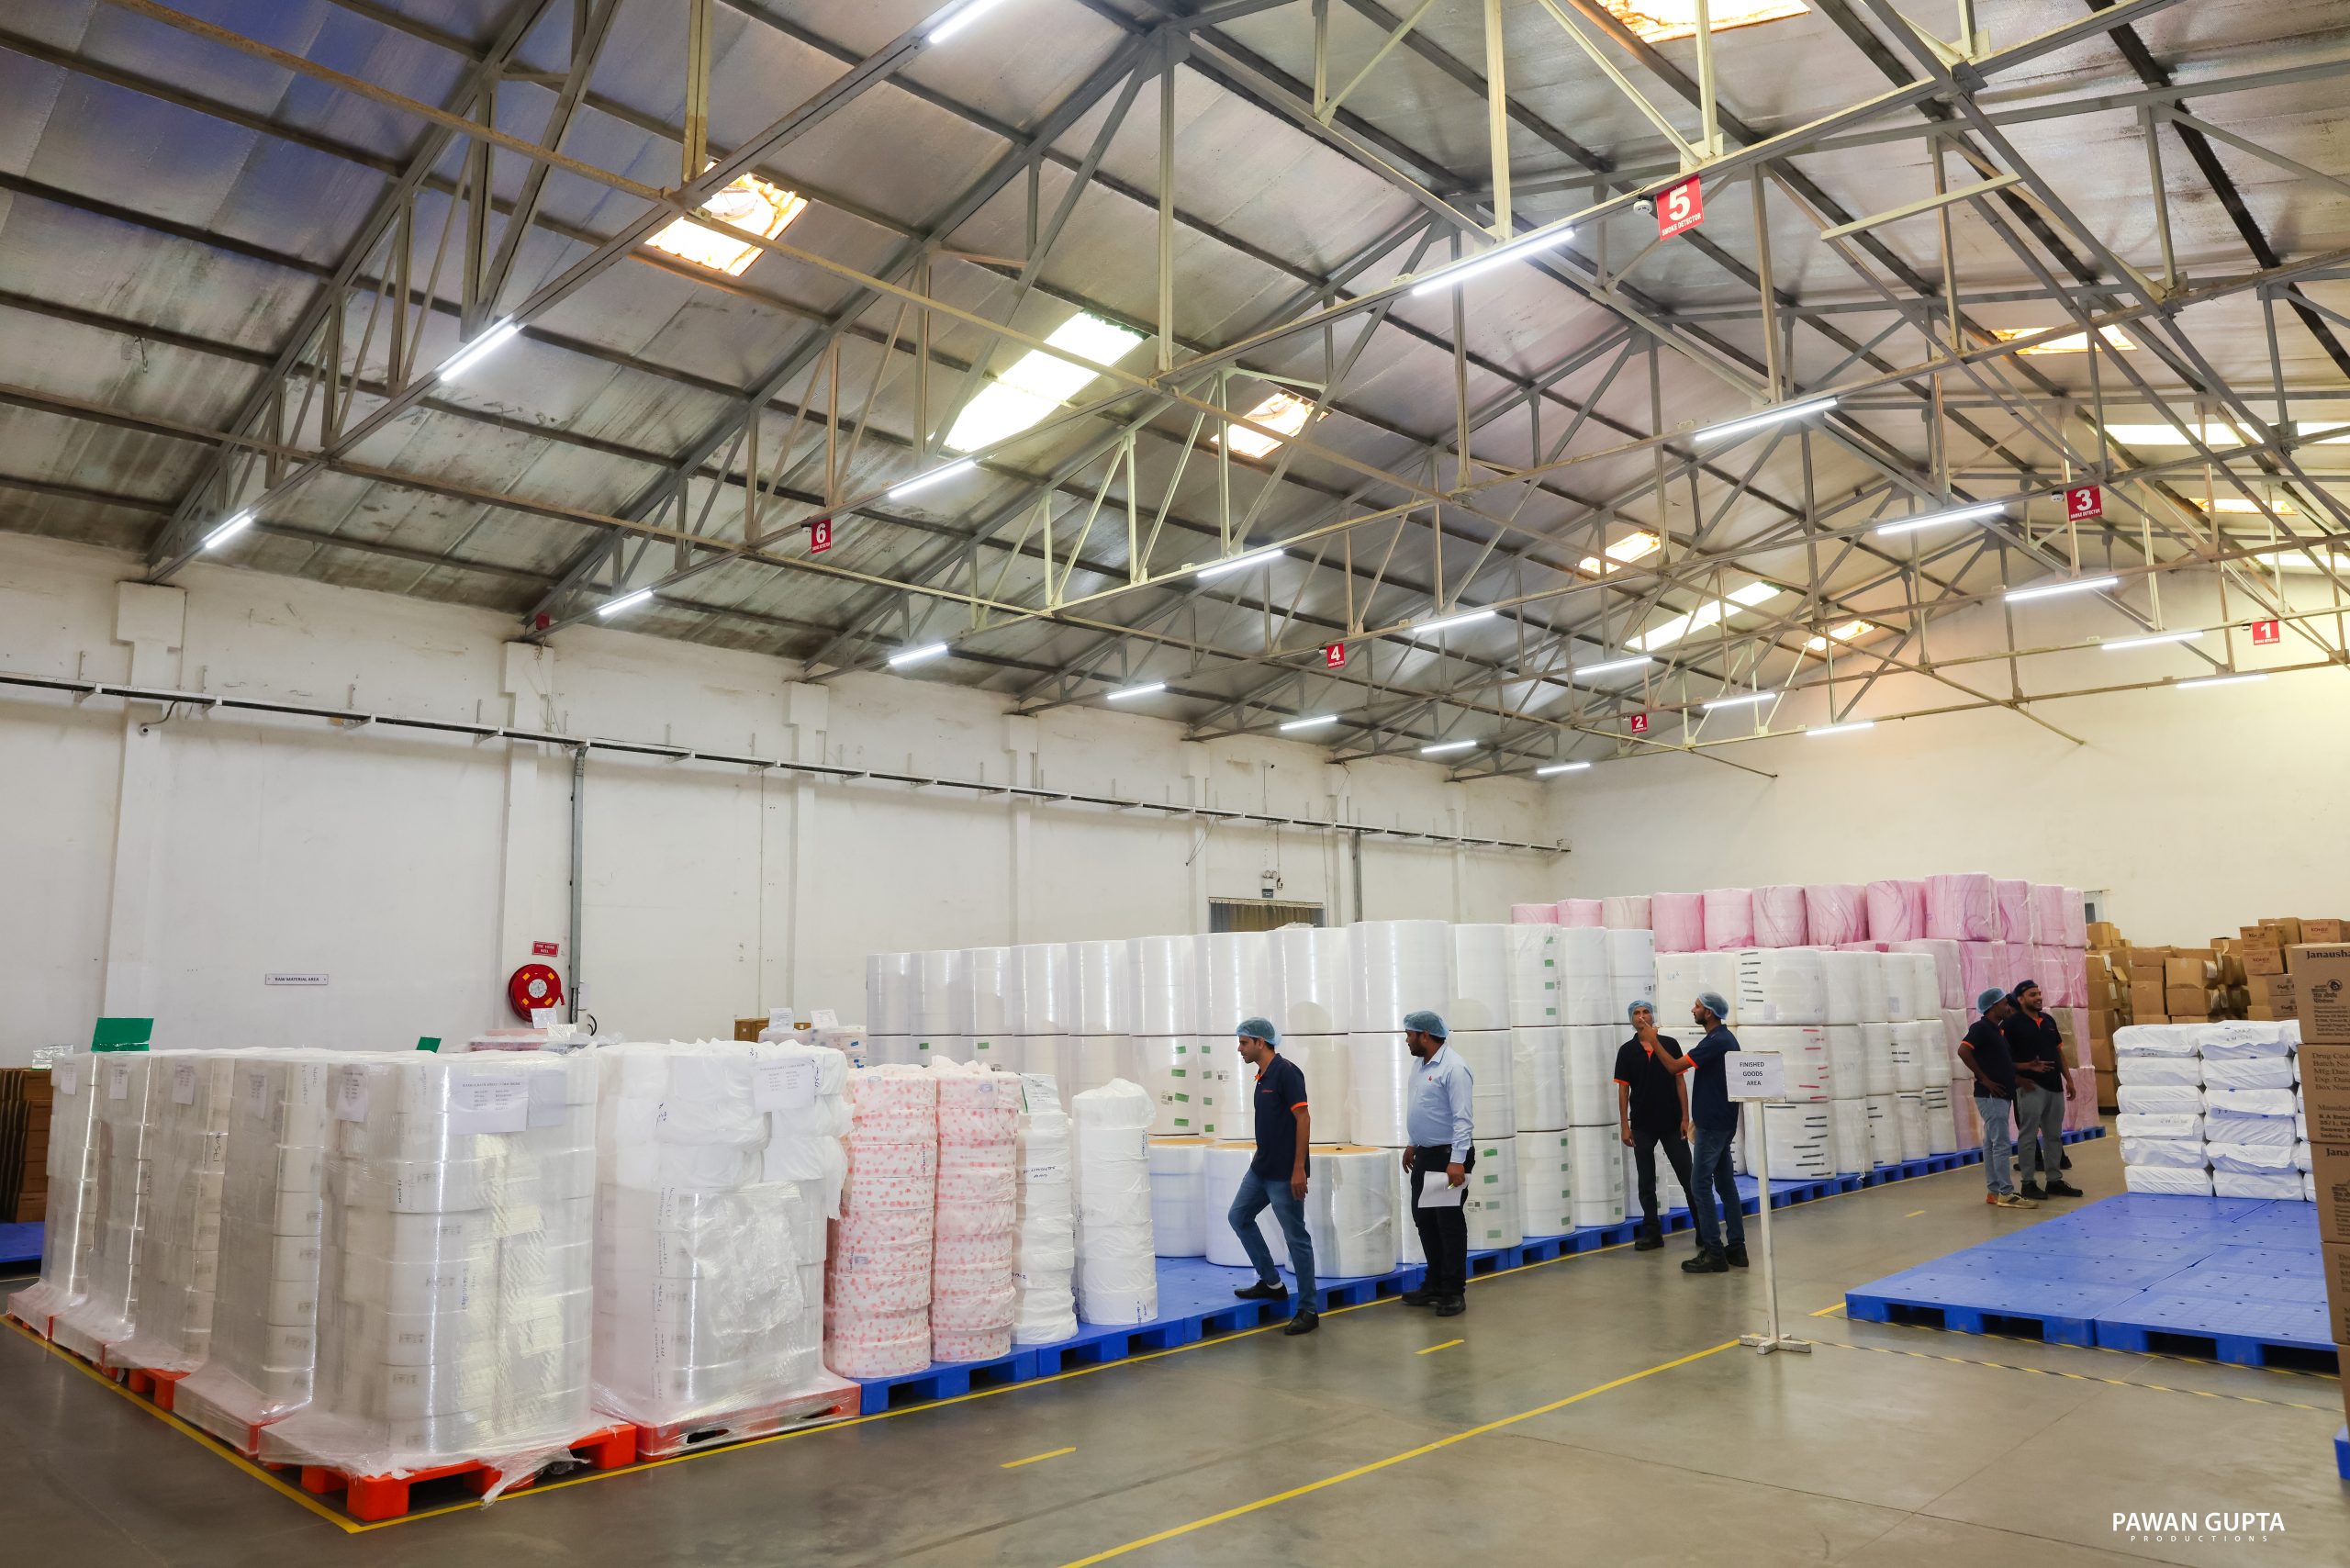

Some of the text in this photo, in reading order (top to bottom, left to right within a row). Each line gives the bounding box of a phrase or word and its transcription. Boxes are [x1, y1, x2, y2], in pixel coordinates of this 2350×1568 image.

[1669, 185, 1690, 220] 5
[1662, 213, 1701, 236] SMOKE DETECTOR
[2076, 489, 2092, 510] 3
[816, 523, 826, 543] 6
[2261, 622, 2271, 638] 1
[1331, 646, 1340, 660] 4
[1635, 716, 1643, 728] 2
[2326, 1148, 2350, 1157] Jana
